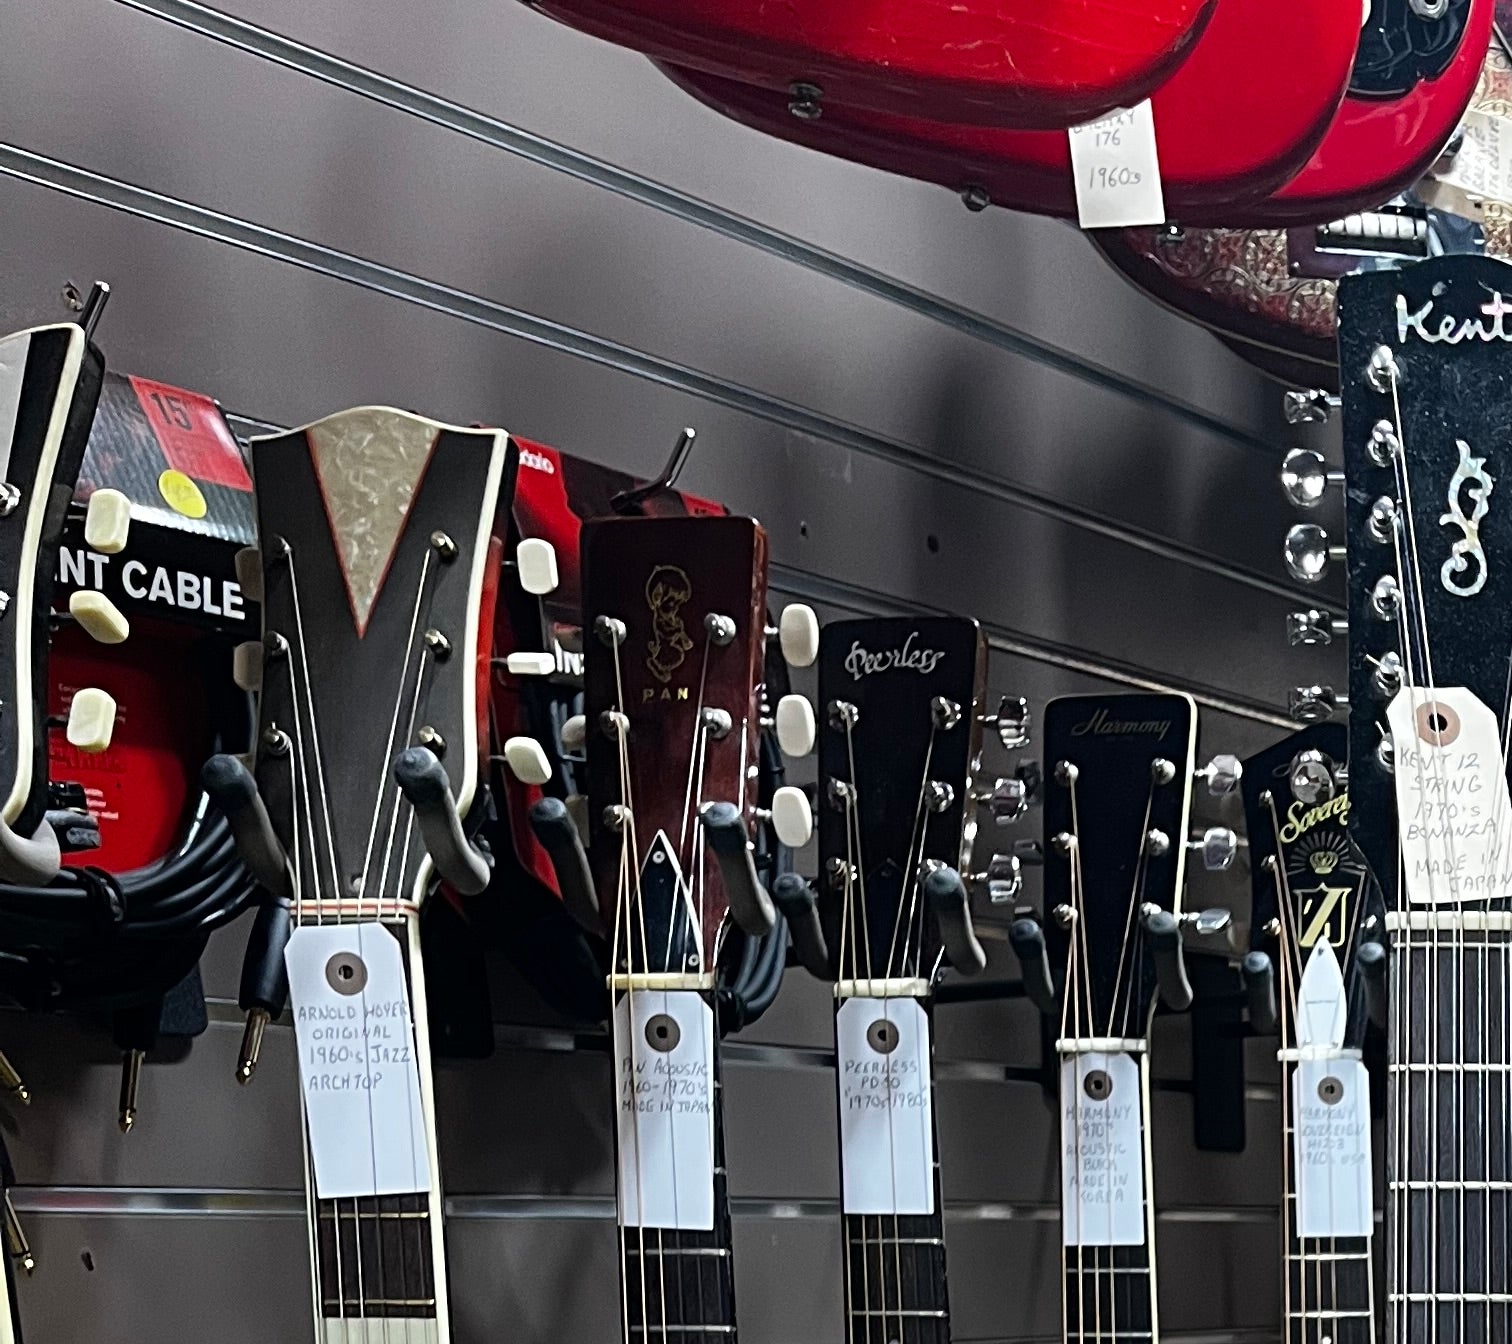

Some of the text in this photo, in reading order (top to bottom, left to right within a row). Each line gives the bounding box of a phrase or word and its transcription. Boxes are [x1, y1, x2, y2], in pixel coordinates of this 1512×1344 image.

[54, 546, 246, 621] NT CABLE
[844, 631, 946, 681] Peerless
[642, 687, 690, 703] PAN
[1070, 707, 1172, 741] Harmony
[1400, 747, 1480, 771] KENT 12
[1410, 774, 1482, 795] STRING
[1406, 817, 1497, 841] BONANZA
[1415, 842, 1503, 879] MADE IN
[298, 1000, 408, 1021] ARNOLD HOYER
[312, 1025, 392, 1040] ORIGINAL
[370, 1044, 411, 1064] JAZZ
[1065, 1142, 1127, 1157] AOUSTIC
